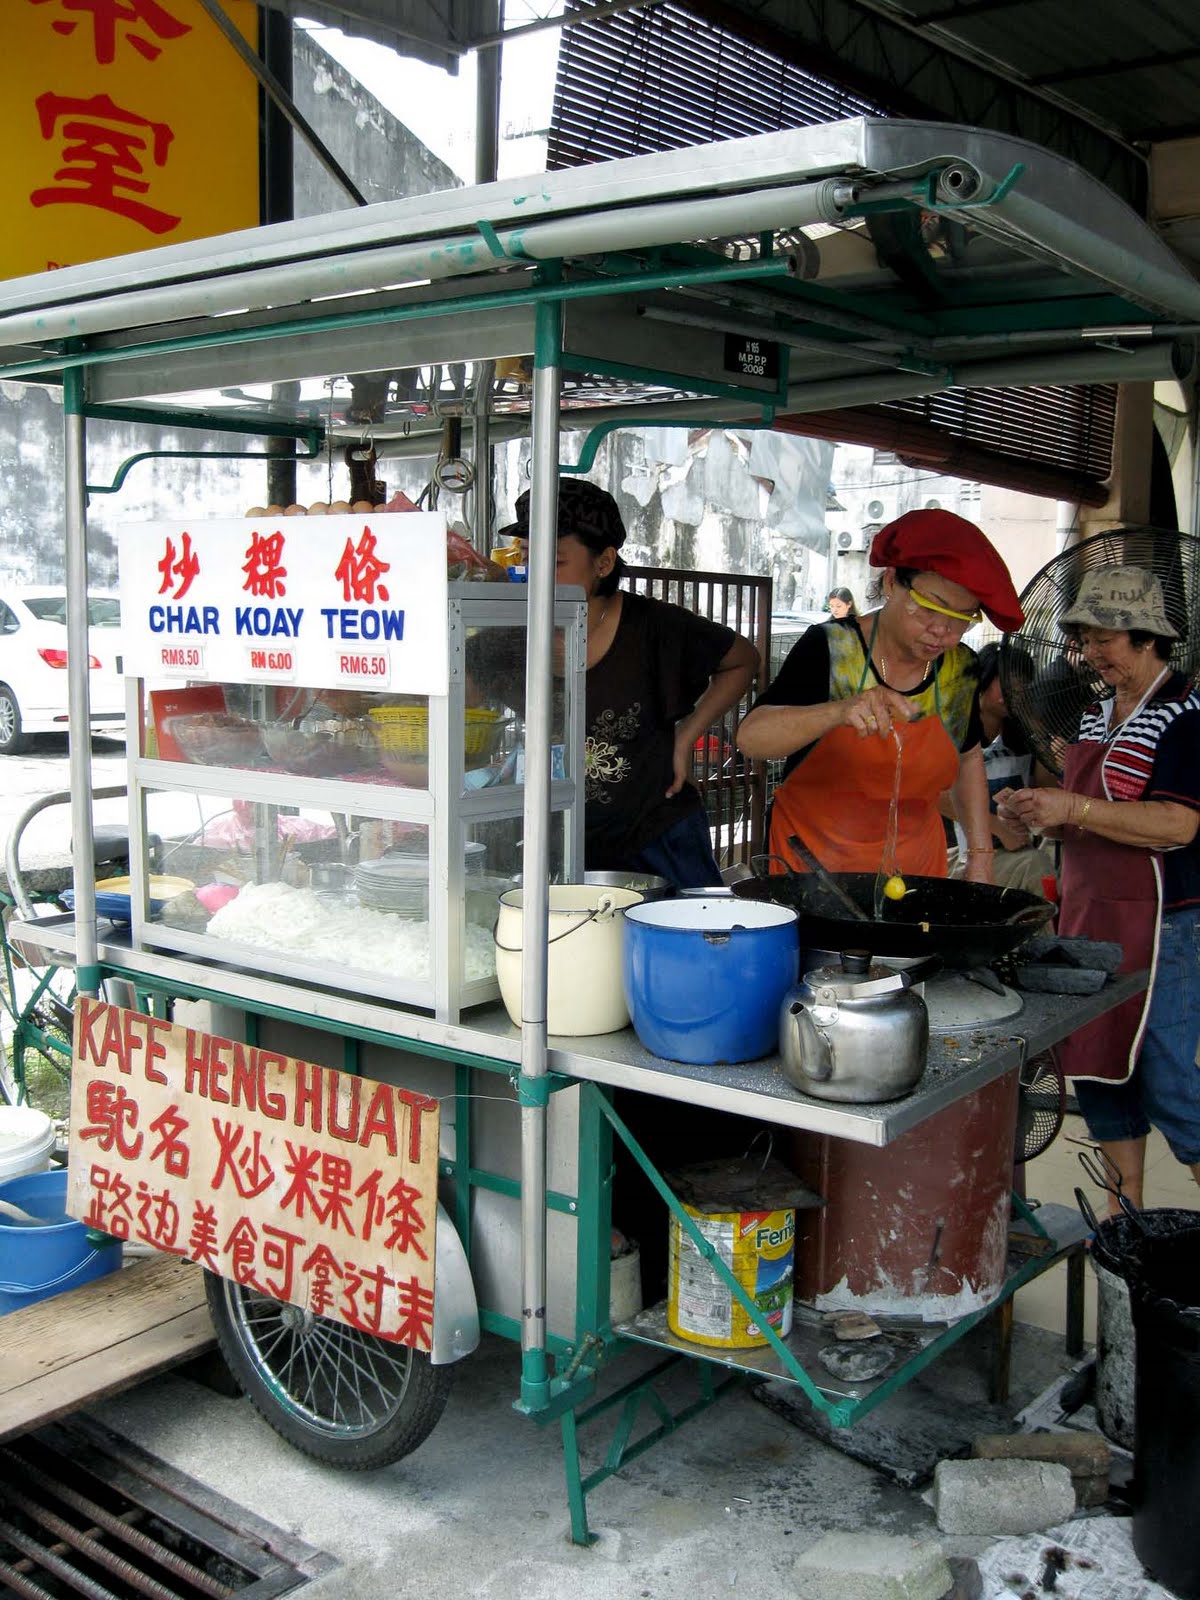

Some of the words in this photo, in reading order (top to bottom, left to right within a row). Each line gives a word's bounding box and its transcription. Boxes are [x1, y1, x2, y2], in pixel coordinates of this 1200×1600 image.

[742, 363, 764, 375] 2008
[149, 605, 219, 635] CHAR
[235, 607, 304, 637] KOAY
[320, 608, 405, 641] TEOW
[161, 649, 199, 666] RM8.50
[339, 655, 386, 675] RM6.50
[79, 998, 172, 1085] KAFE
[184, 1029, 289, 1121] HENG
[294, 1061, 440, 1163] HUAT
